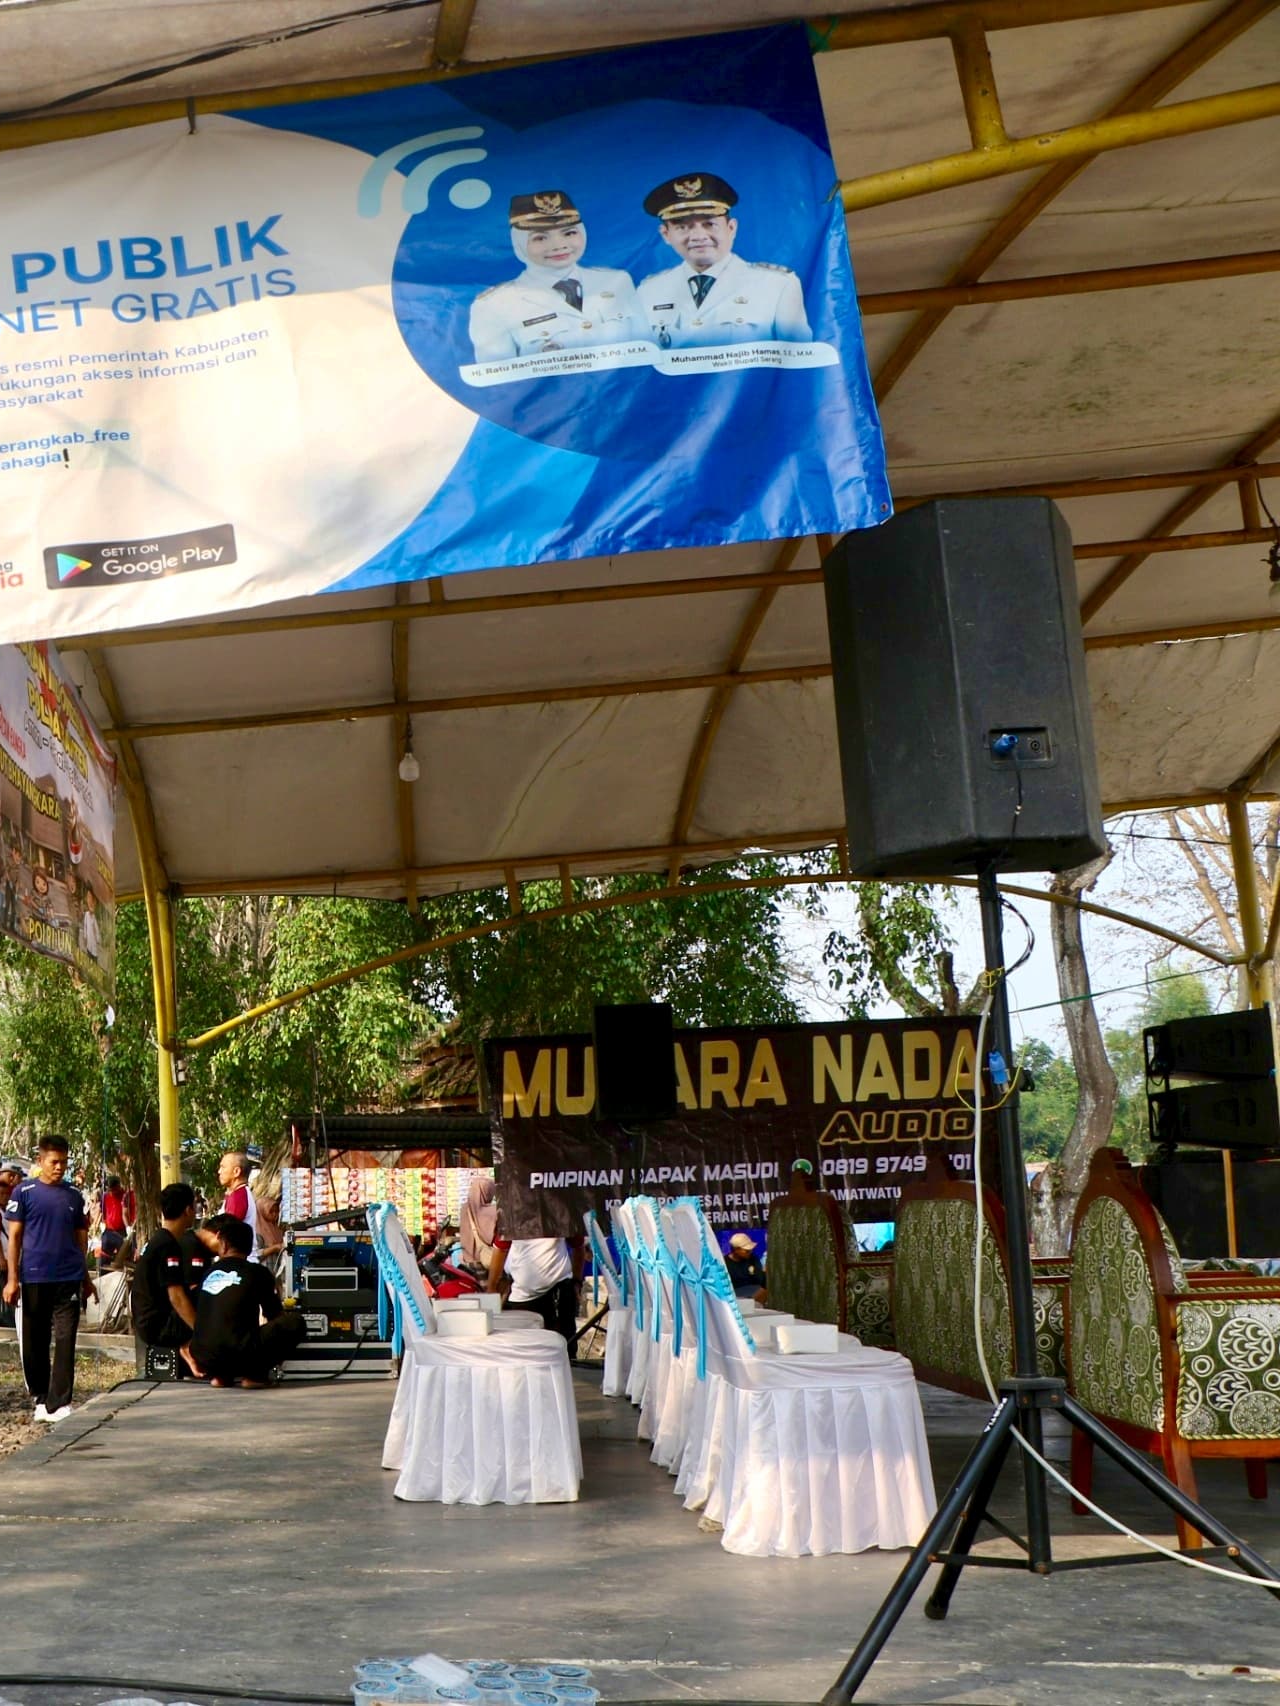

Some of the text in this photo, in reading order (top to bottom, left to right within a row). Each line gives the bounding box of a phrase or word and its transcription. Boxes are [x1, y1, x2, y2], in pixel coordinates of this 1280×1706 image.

[11, 214, 289, 295] PUBLIK
[111, 268, 297, 323] GRATIS
[15, 355, 64, 372] resmi
[68, 349, 169, 366] Pemerintah
[174, 328, 270, 358] Kabupaten
[82, 368, 134, 382] akses
[138, 357, 220, 380] informasi
[224, 347, 258, 364] dan
[671, 352, 725, 364] Muhammad
[726, 350, 750, 360] Najib
[760, 355, 783, 365] Serang
[485, 366, 510, 376] Ratu
[532, 361, 593, 374] Bupati Serang
[101, 543, 159, 558] GET IT ON
[102, 546, 225, 576] Google Play
[503, 1029, 986, 1118] MUARA NADA
[819, 1108, 977, 1145] AUDIO
[529, 1169, 624, 1189] PIMPINAN
[703, 1161, 779, 1181] MASUDI
[822, 1157, 868, 1176] 0819
[875, 1155, 928, 1174] 9749
[699, 1194, 721, 1207] ESA
[816, 1186, 902, 1201] MATWATU
[705, 1208, 748, 1223] ERANG
